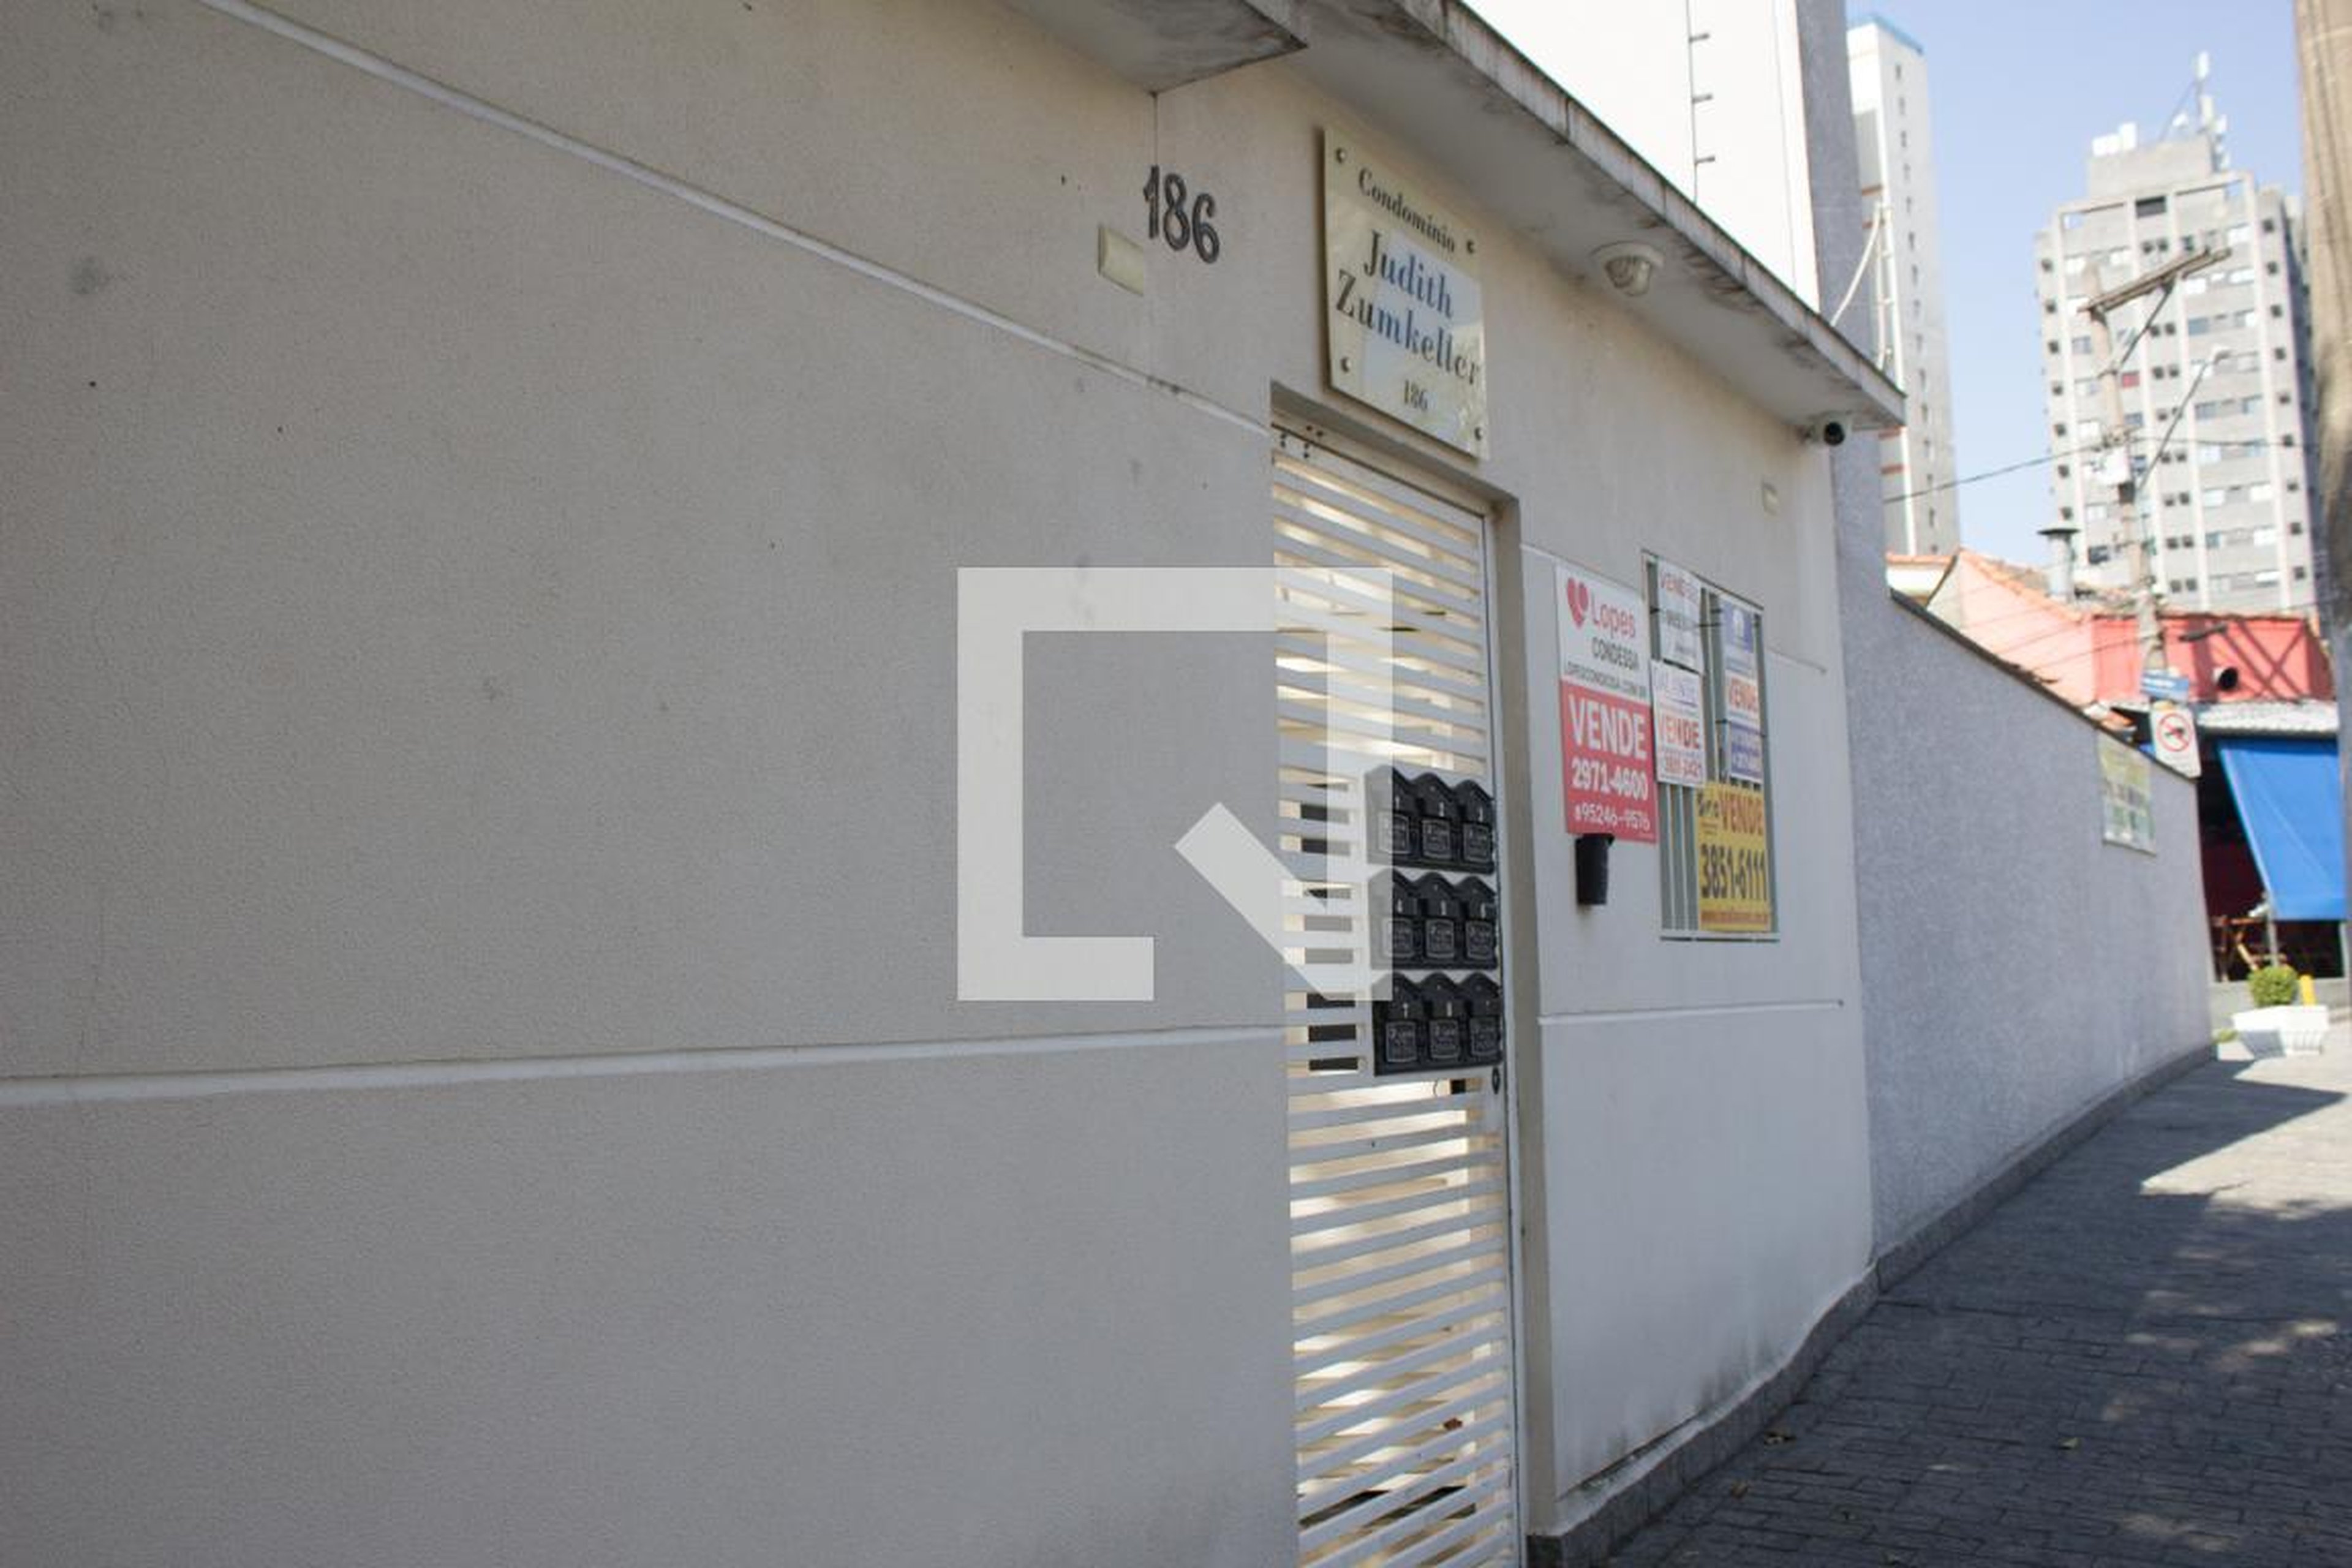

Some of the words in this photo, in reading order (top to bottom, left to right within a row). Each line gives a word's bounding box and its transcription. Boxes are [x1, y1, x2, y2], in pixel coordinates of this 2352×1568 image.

[1143, 165, 1220, 263] 186
[1363, 228, 1452, 319] Judith
[1335, 268, 1481, 385] Zumkeller
[1404, 379, 1429, 412] 186
[1592, 592, 1636, 639] Lopes
[1568, 693, 1648, 760] VENDE
[1654, 709, 1700, 750] VENDE
[1571, 756, 1649, 801] 2971-4600
[1719, 785, 1765, 837] VENDE
[1700, 843, 1768, 902] 3851-6111
